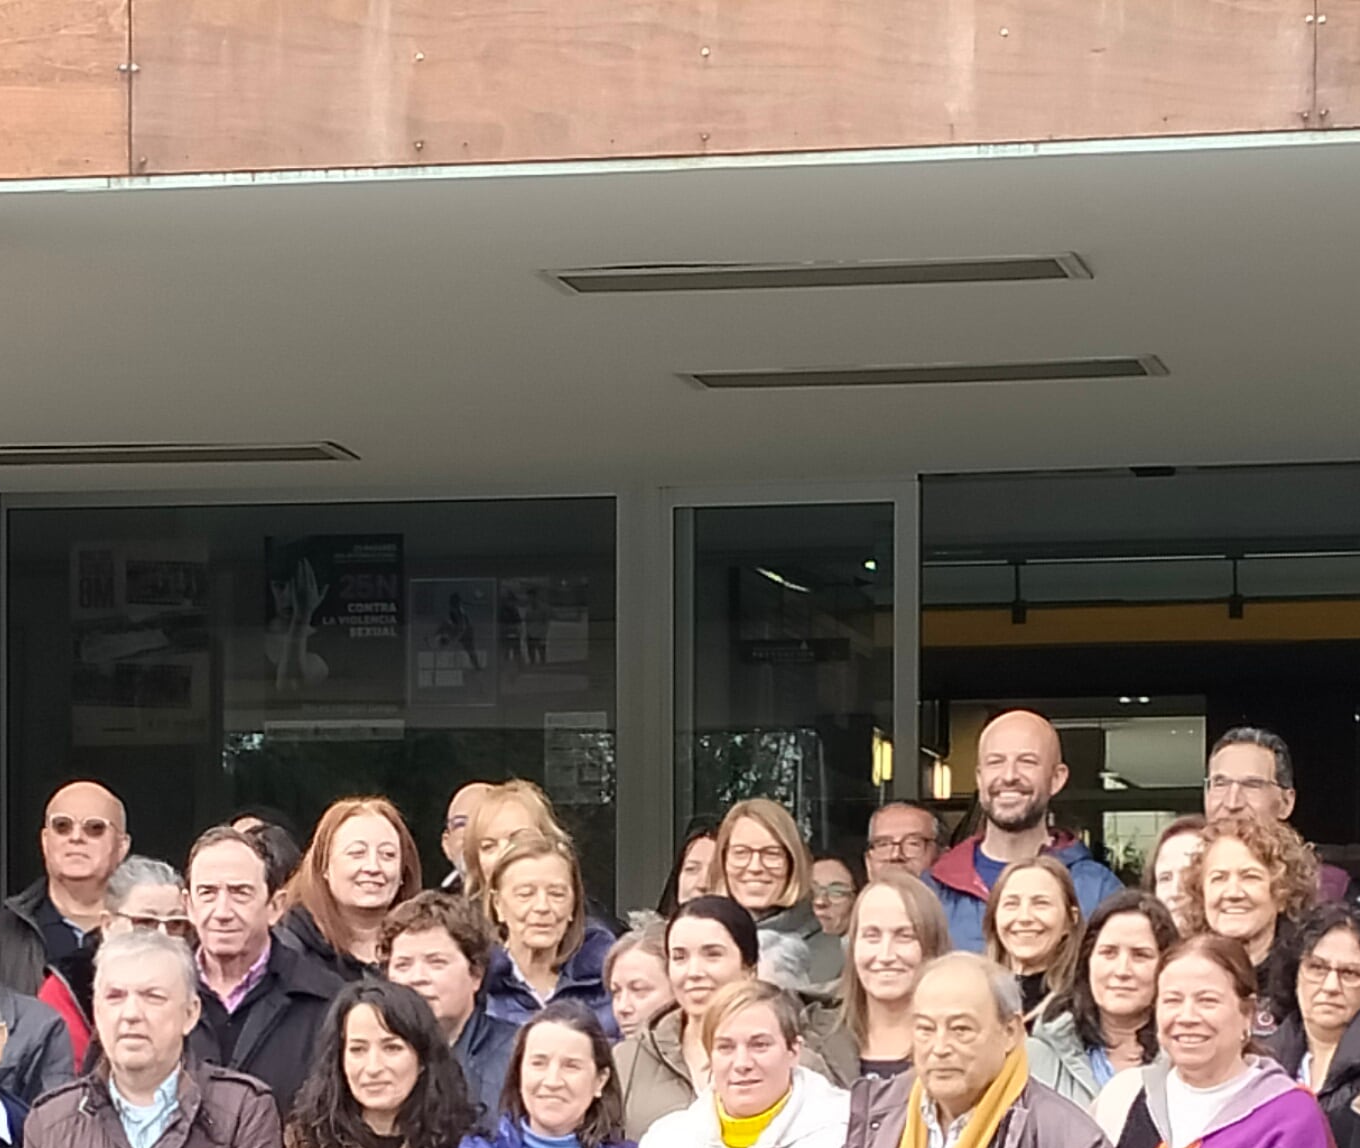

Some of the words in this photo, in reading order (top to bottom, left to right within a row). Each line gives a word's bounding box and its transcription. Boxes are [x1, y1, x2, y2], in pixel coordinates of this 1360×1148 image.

[339, 572, 398, 598] 25N
[346, 602, 398, 614] CONTRA
[322, 615, 337, 626] LA
[338, 615, 398, 626] VIOLENCIA
[348, 626, 398, 638] SEXUAL
